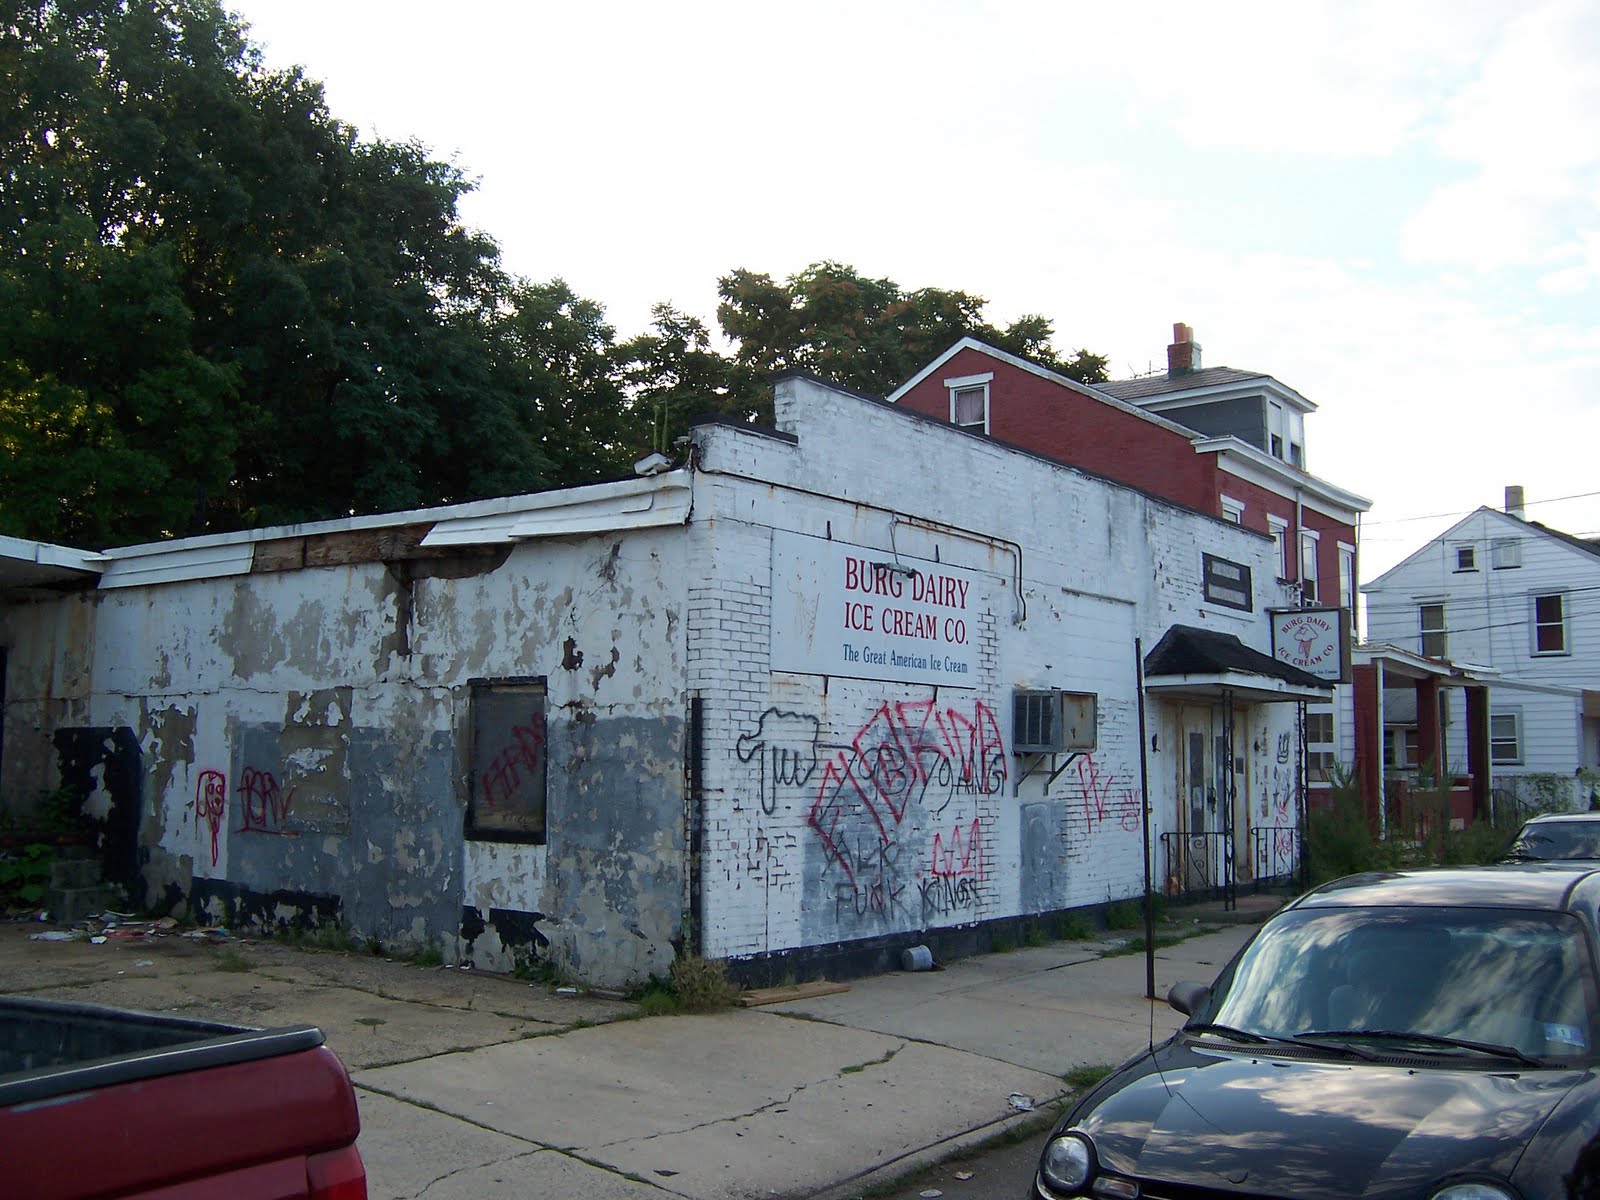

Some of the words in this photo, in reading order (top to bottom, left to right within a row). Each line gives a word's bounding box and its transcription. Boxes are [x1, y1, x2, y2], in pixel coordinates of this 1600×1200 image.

[845, 557, 903, 598] BURG
[912, 570, 970, 609] DAIRY
[844, 602, 873, 631] ICE
[882, 608, 937, 640] CREAM
[944, 617, 969, 645] CO.
[1281, 616, 1303, 634] BURG
[1306, 616, 1332, 632] DAIRY
[843, 643, 860, 662] The
[863, 645, 886, 665] Great
[890, 650, 927, 669] American
[930, 654, 941, 671] Ice
[944, 656, 968, 673] Cream
[1278, 646, 1291, 660] ICE
[1293, 656, 1323, 666] CREAM
[1323, 644, 1334, 657] CO
